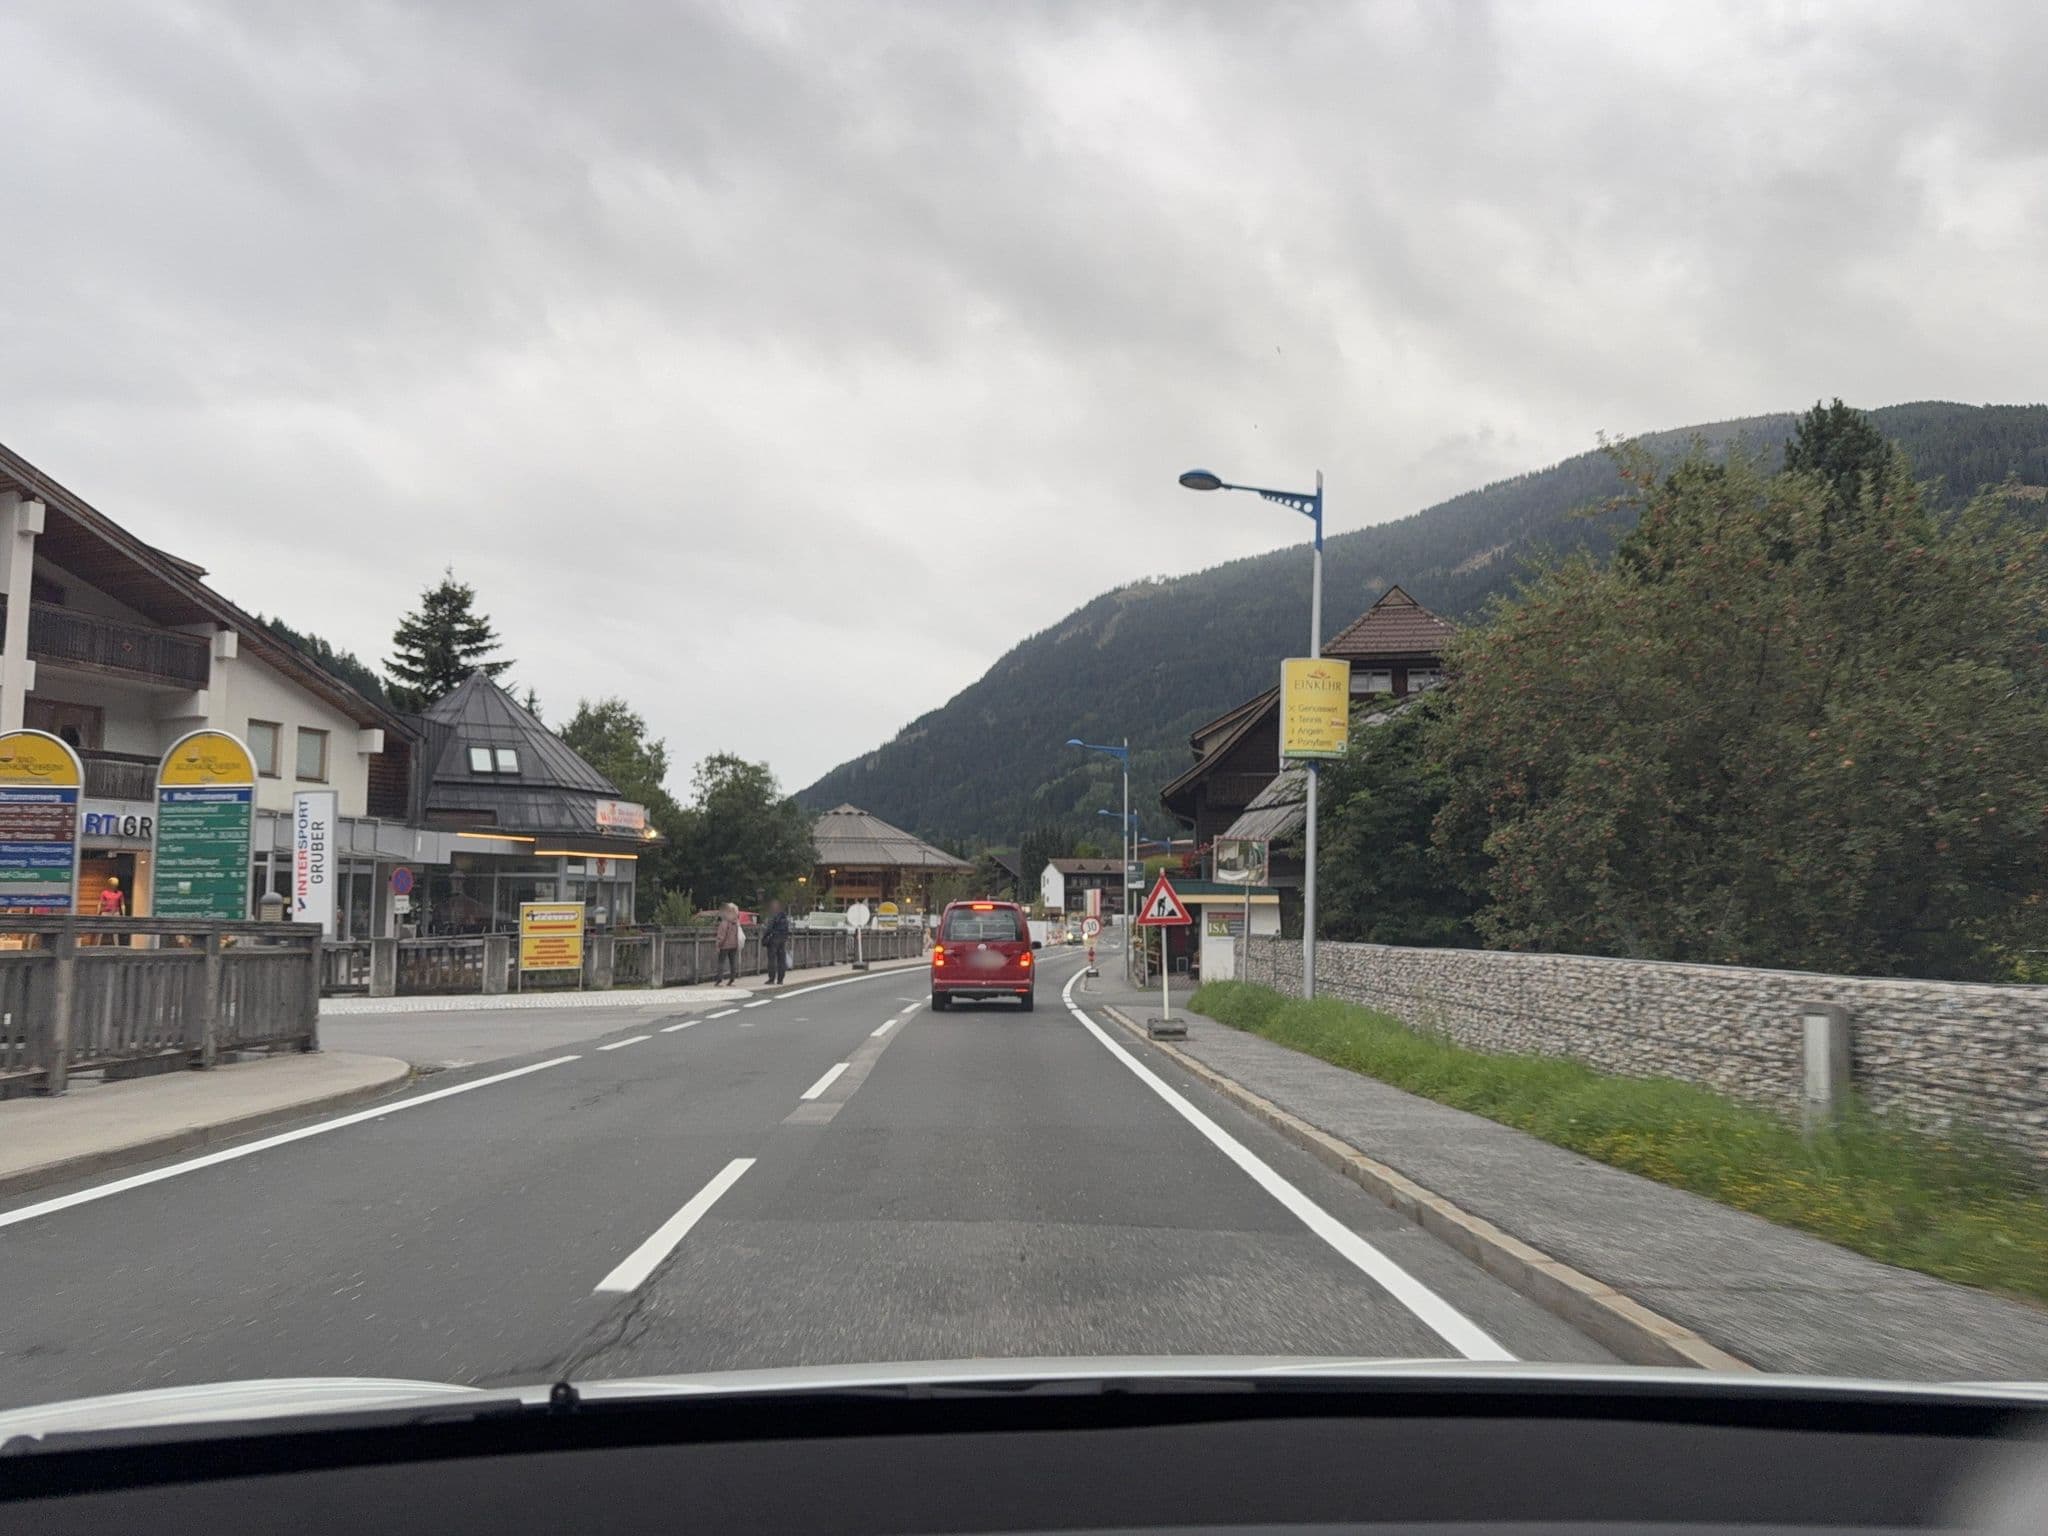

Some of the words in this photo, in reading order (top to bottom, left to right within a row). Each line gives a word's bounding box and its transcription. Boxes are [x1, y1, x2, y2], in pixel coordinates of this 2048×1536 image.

[1294, 679, 1342, 692] EINKEHR
[297, 800, 309, 896] INTERSPORT
[310, 821, 324, 884] GRUBER
